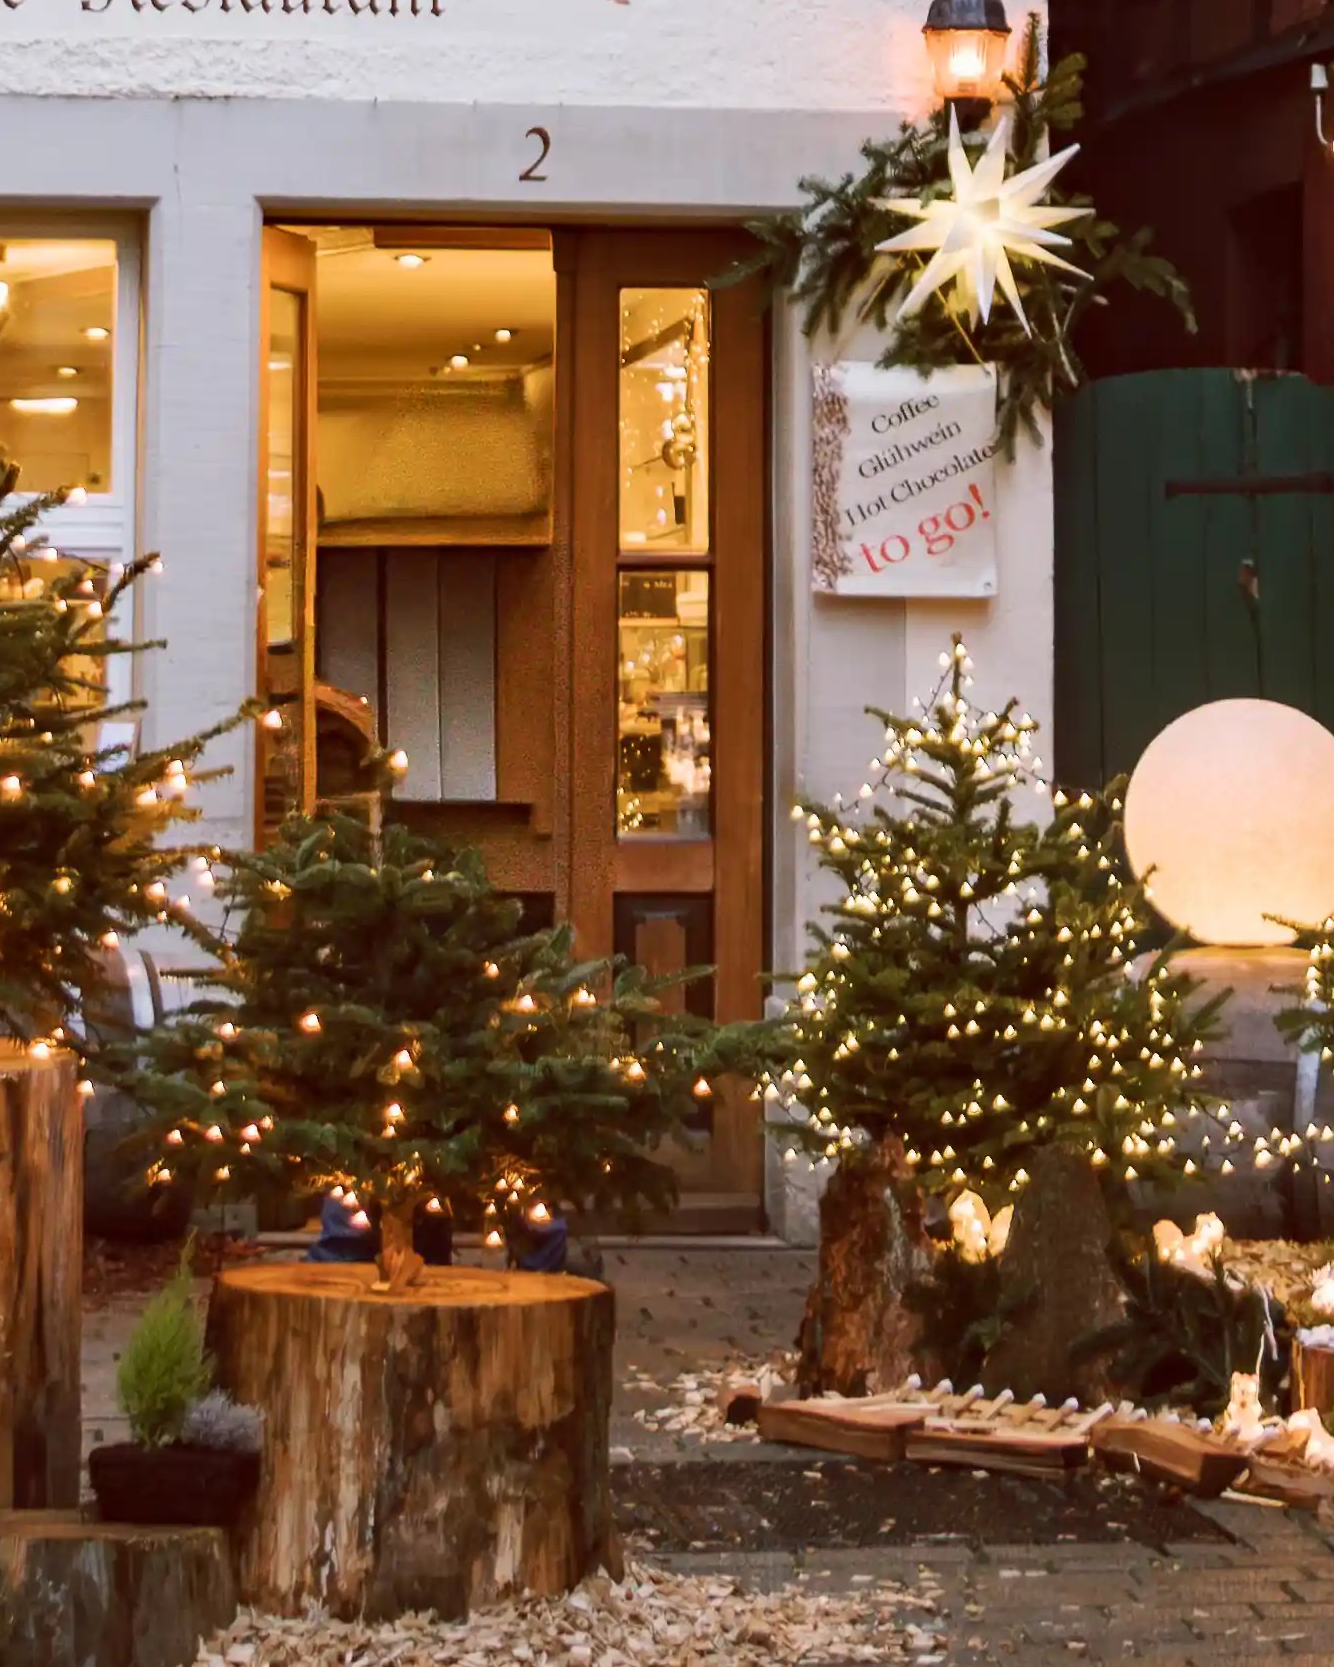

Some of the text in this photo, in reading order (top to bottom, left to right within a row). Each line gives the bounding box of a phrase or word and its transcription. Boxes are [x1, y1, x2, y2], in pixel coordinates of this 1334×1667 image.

[518, 126, 551, 183] 2
[871, 394, 940, 434] Coffee
[858, 420, 962, 479] Glühwein
[845, 444, 996, 527] Hot Chocolate
[860, 483, 990, 573] to go!
